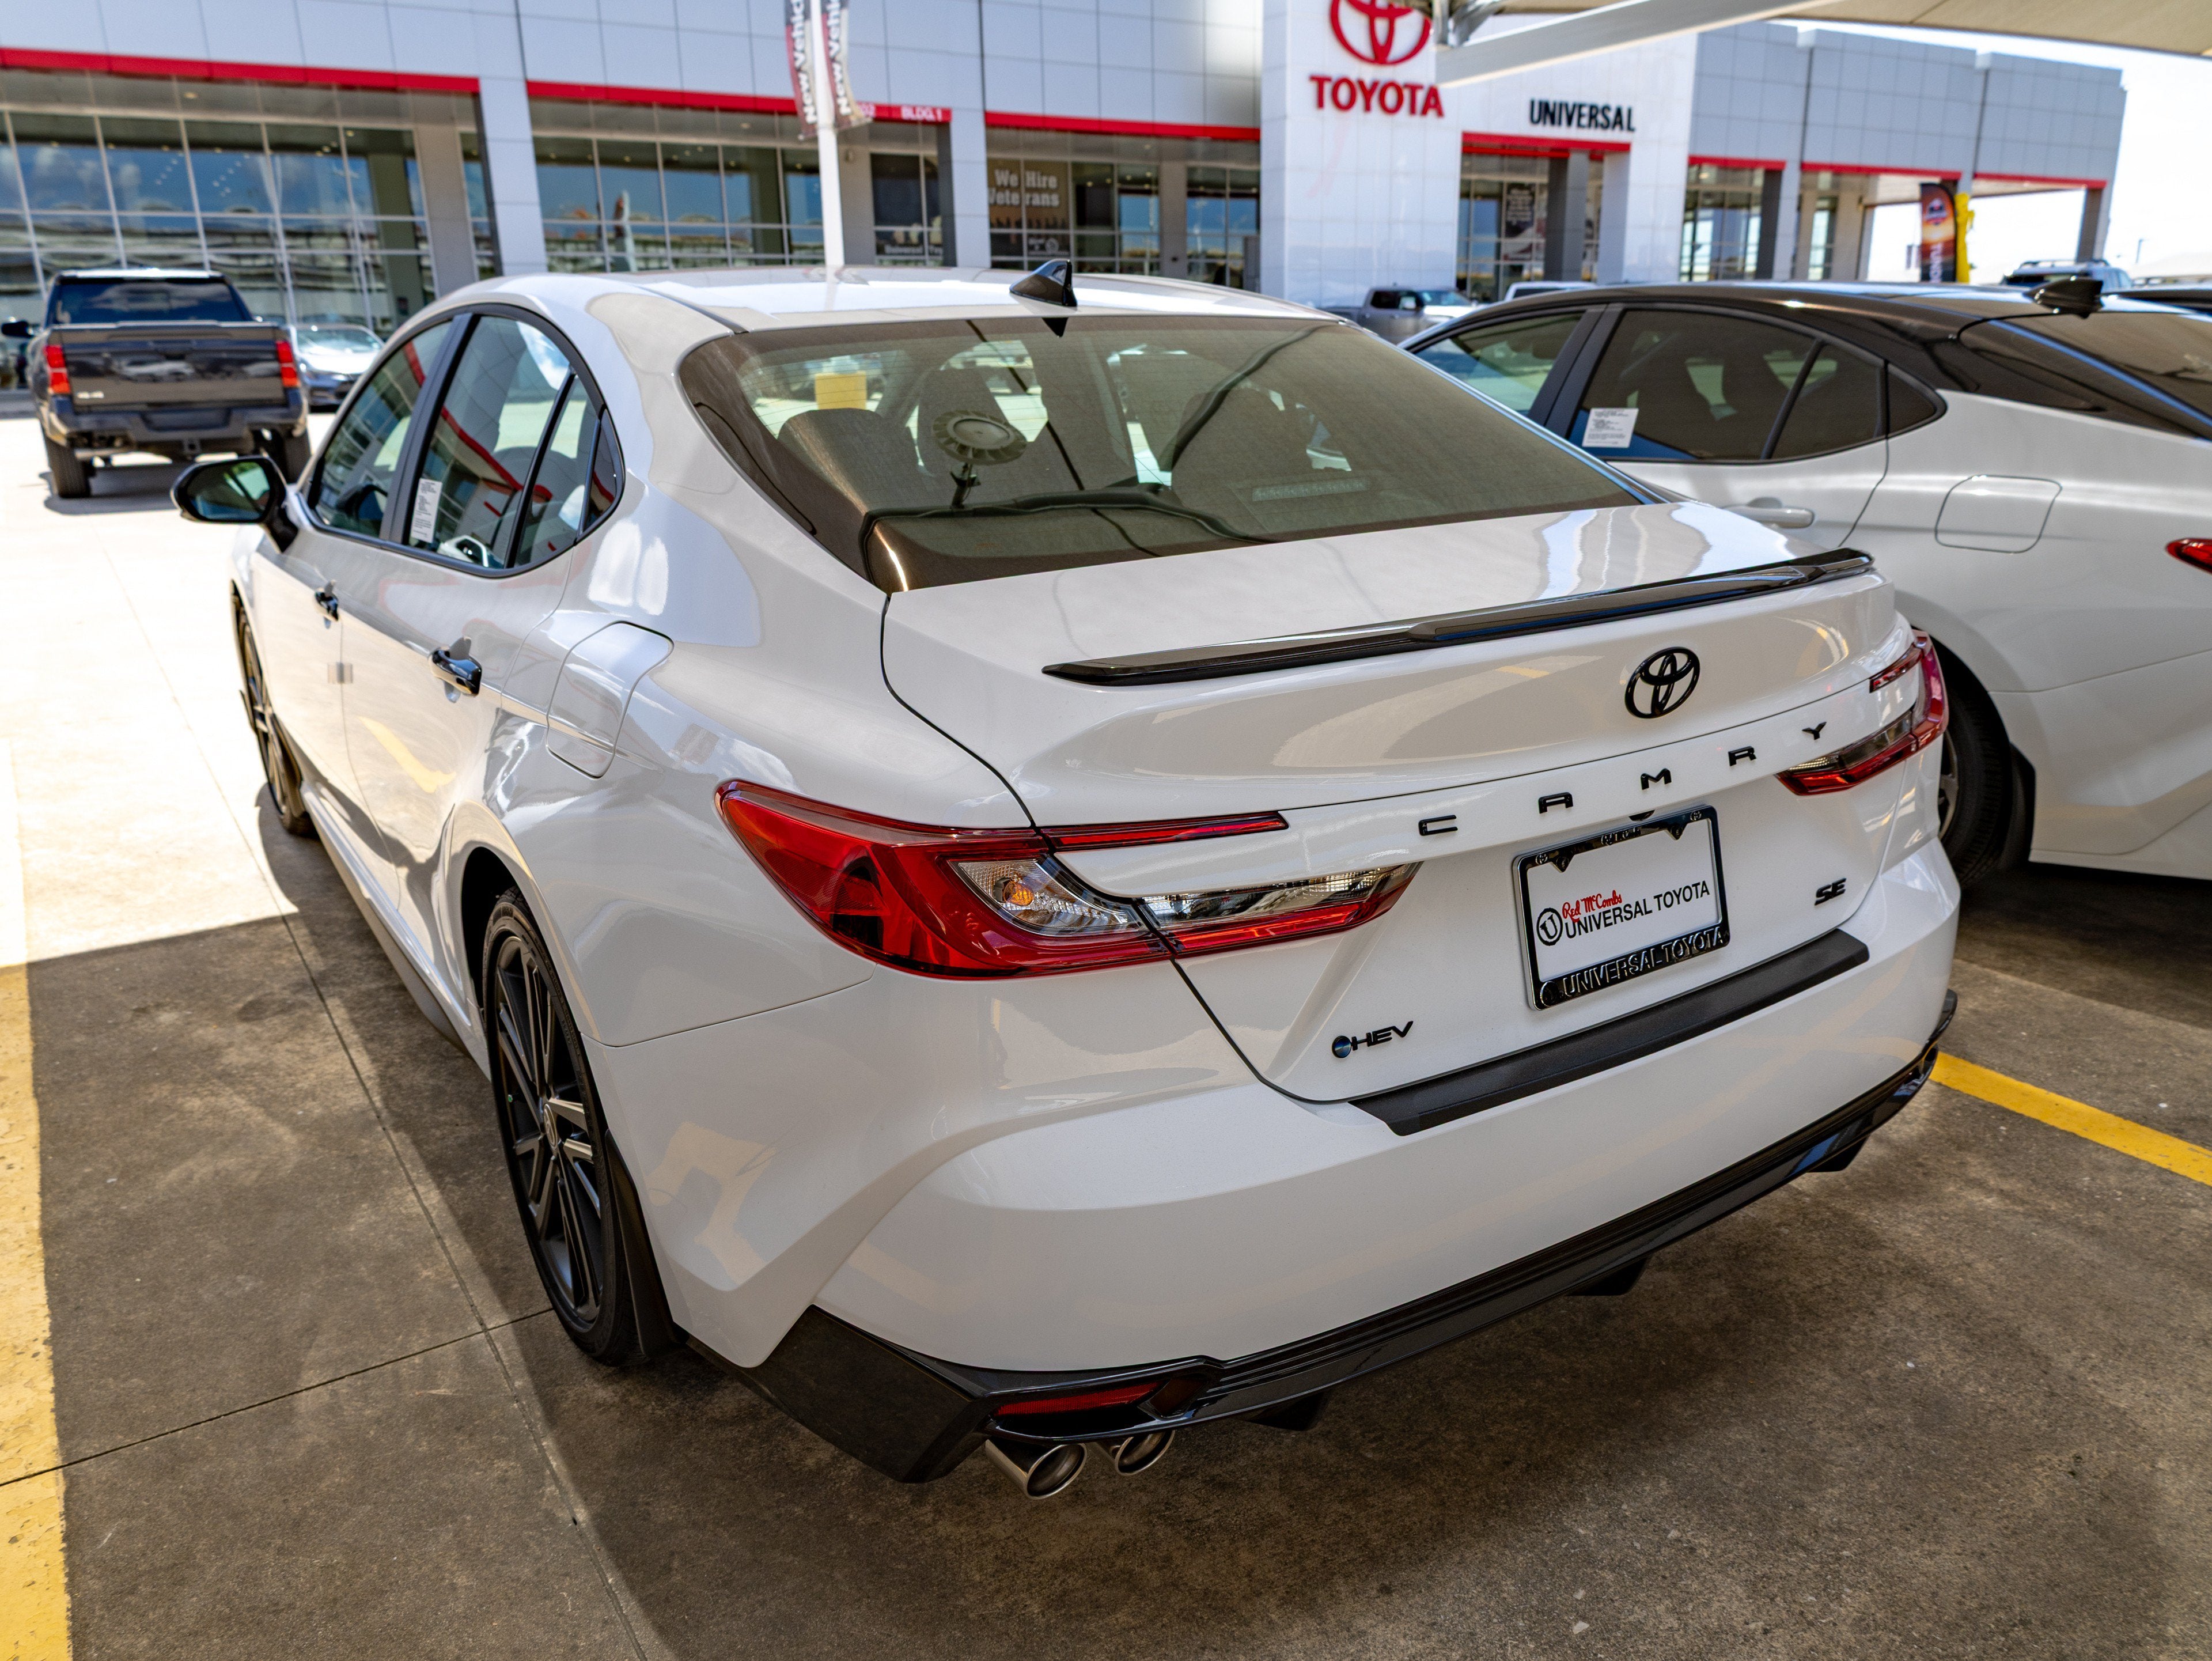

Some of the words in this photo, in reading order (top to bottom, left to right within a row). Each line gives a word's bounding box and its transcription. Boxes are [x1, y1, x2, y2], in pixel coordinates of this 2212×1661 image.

[798, 71, 817, 124] New
[831, 61, 852, 115] New
[1310, 75, 1445, 118] TOYOTA
[1529, 98, 1636, 132] UNIVERSAL
[994, 169, 1019, 187] We
[1025, 171, 1058, 189] Hire
[1418, 721, 1827, 837] CAMRY
[1562, 900, 1581, 922] Red
[1581, 890, 1623, 912] McCombs
[1565, 898, 1653, 939] UNIVERSAL
[1654, 880, 1710, 911] TOYOTA
[1814, 877, 1847, 906] SE
[1563, 948, 1662, 997] UNIVERSAL
[1661, 926, 1724, 959] TOYOTA
[1351, 1020, 1414, 1051] HEV
